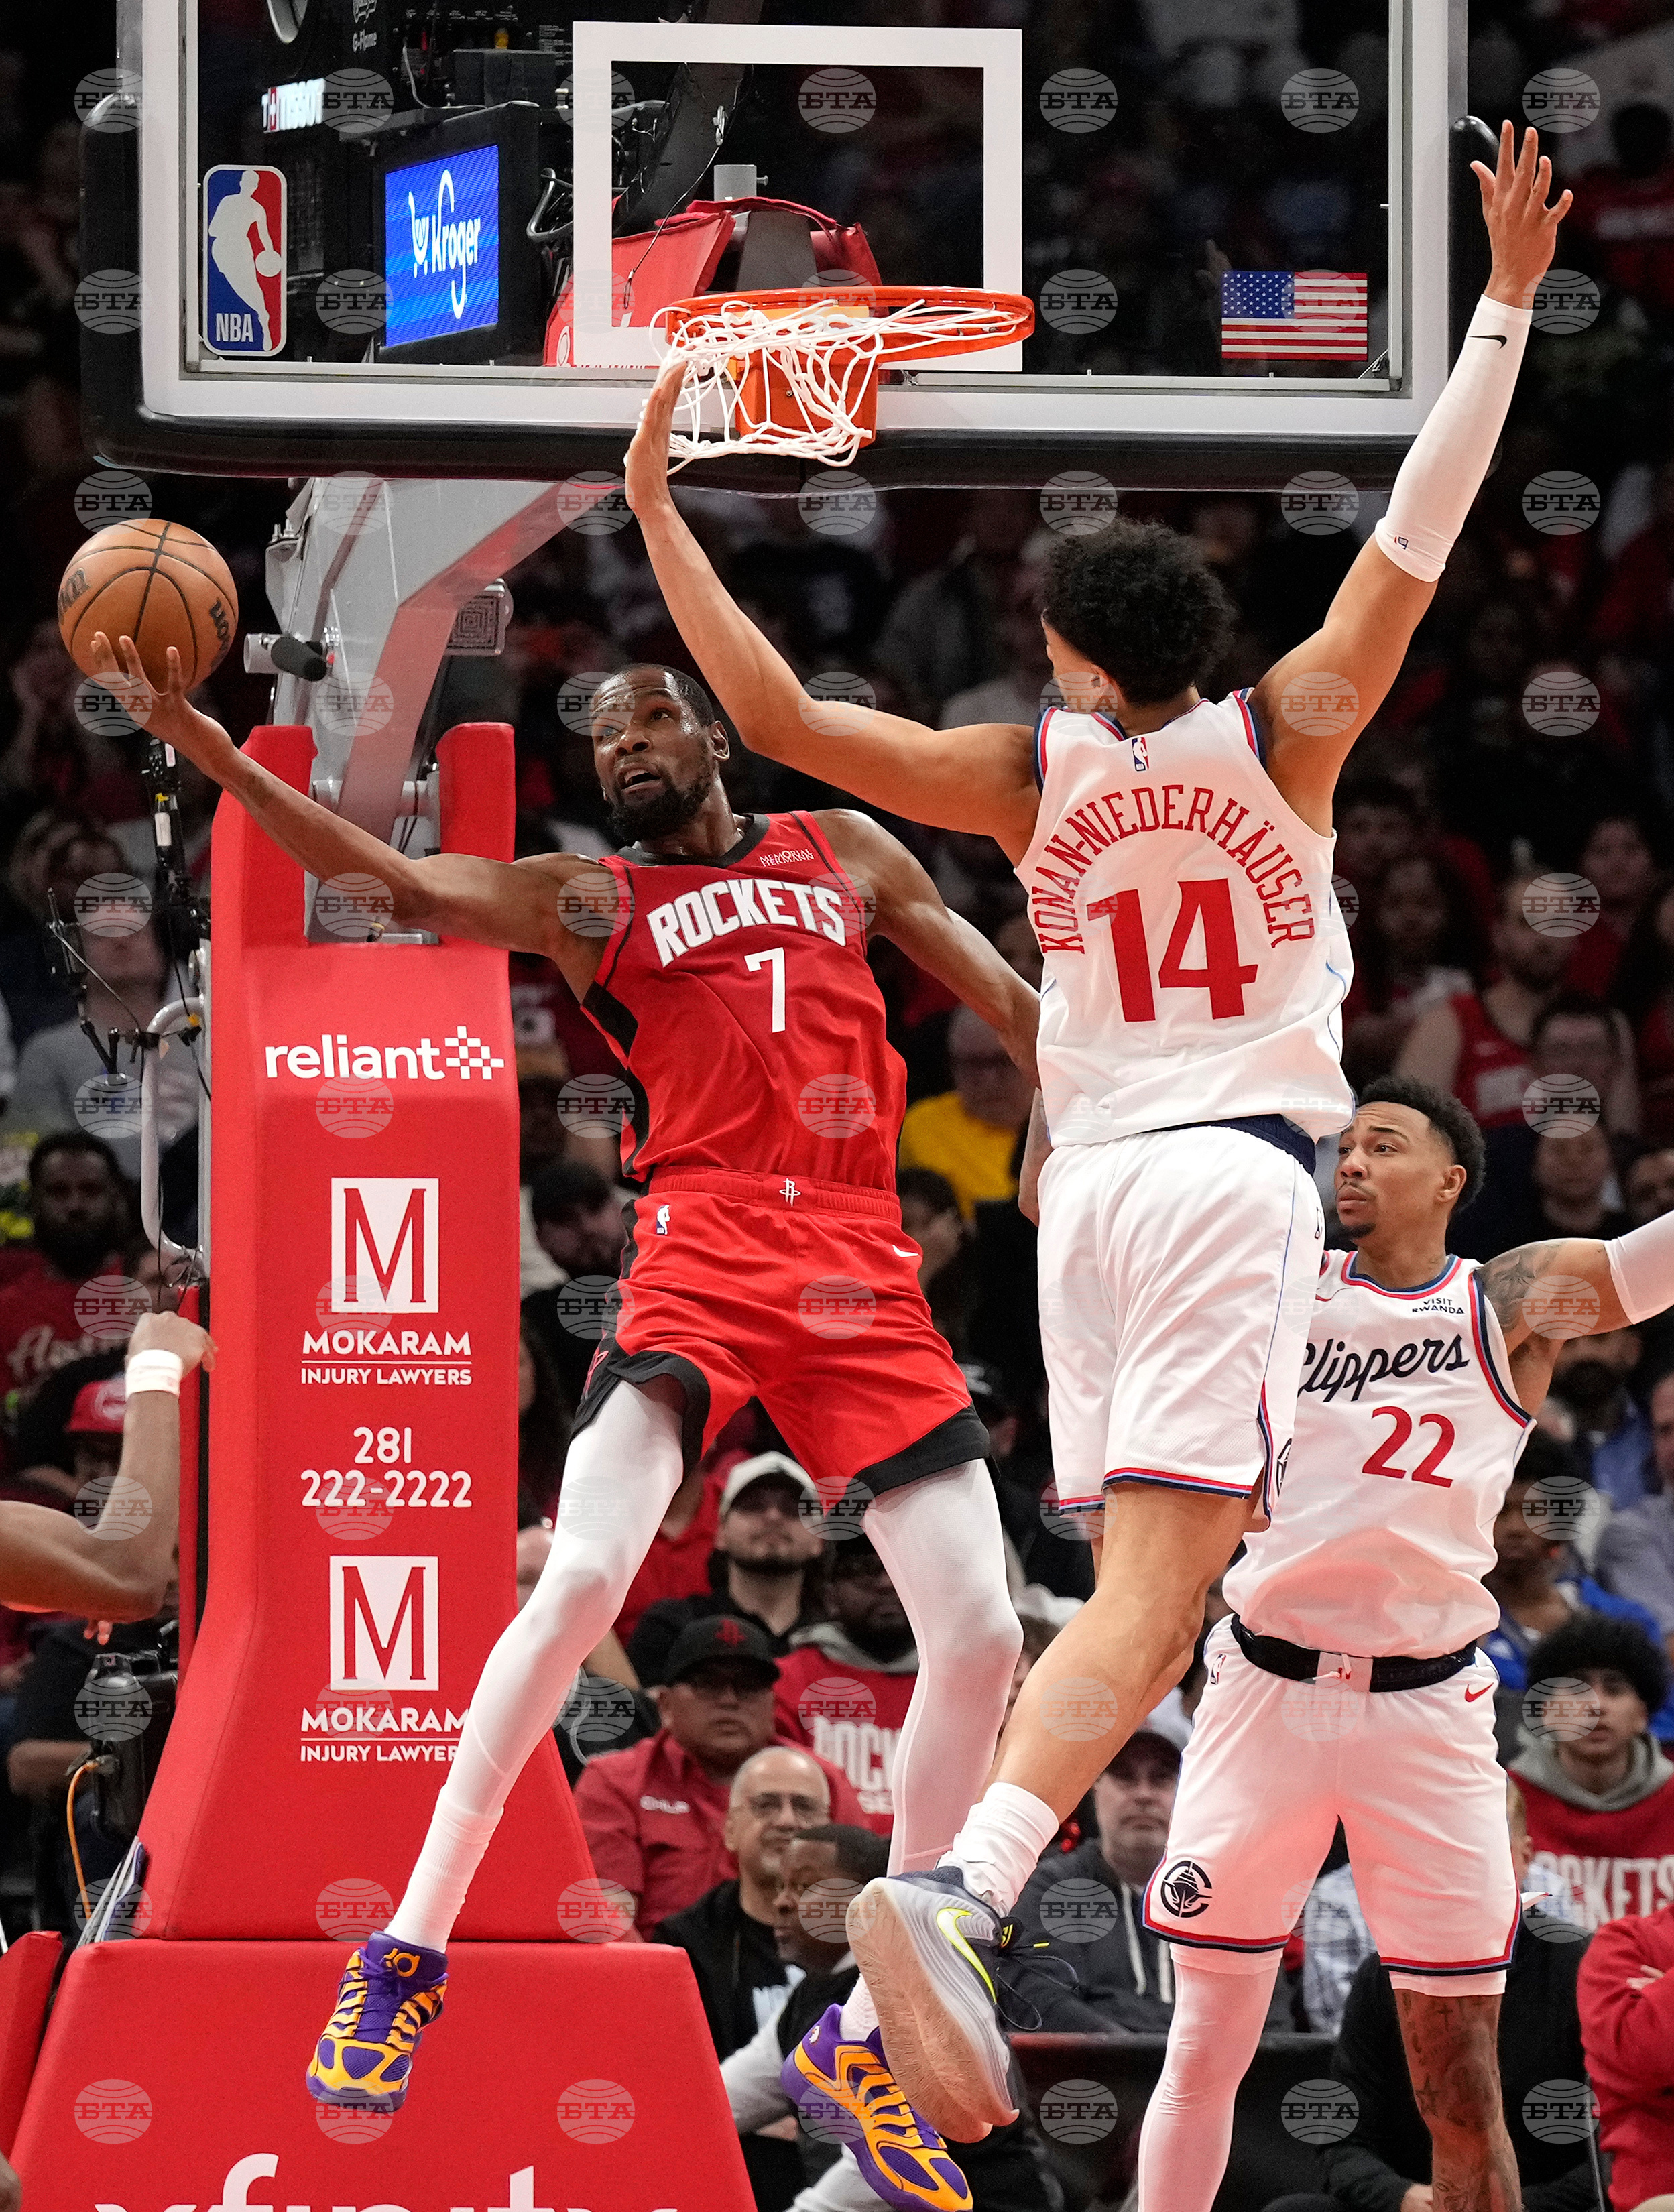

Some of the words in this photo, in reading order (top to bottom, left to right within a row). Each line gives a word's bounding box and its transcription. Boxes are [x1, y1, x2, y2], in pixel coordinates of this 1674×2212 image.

[431, 170, 481, 320] Kroger
[215, 312, 254, 343] NBA
[760, 849, 813, 863] MEMORIAL
[761, 853, 815, 867] HERMANN
[1032, 784, 1315, 955] KONAN-NIEDERHÄUSER
[646, 878, 846, 968] ROCKETS
[1086, 878, 1259, 1022] 14
[744, 947, 786, 1033] 7
[265, 1034, 446, 1081] reliant
[343, 1188, 427, 1303] M
[1412, 1304, 1465, 1314] RWANDA
[1423, 1297, 1453, 1306] VISIT
[302, 1329, 472, 1355] MOKARAM
[301, 1368, 372, 1385] INJURY
[376, 1368, 473, 1386] LAWYERS
[353, 1426, 412, 1464] 281
[1362, 1405, 1455, 1489] 22
[300, 1469, 473, 1508] 222-2222
[342, 1566, 426, 1680] M
[301, 1707, 470, 1733] MOKARAM
[300, 1745, 371, 1762] INJURY
[376, 1745, 459, 1762] LAWYER
